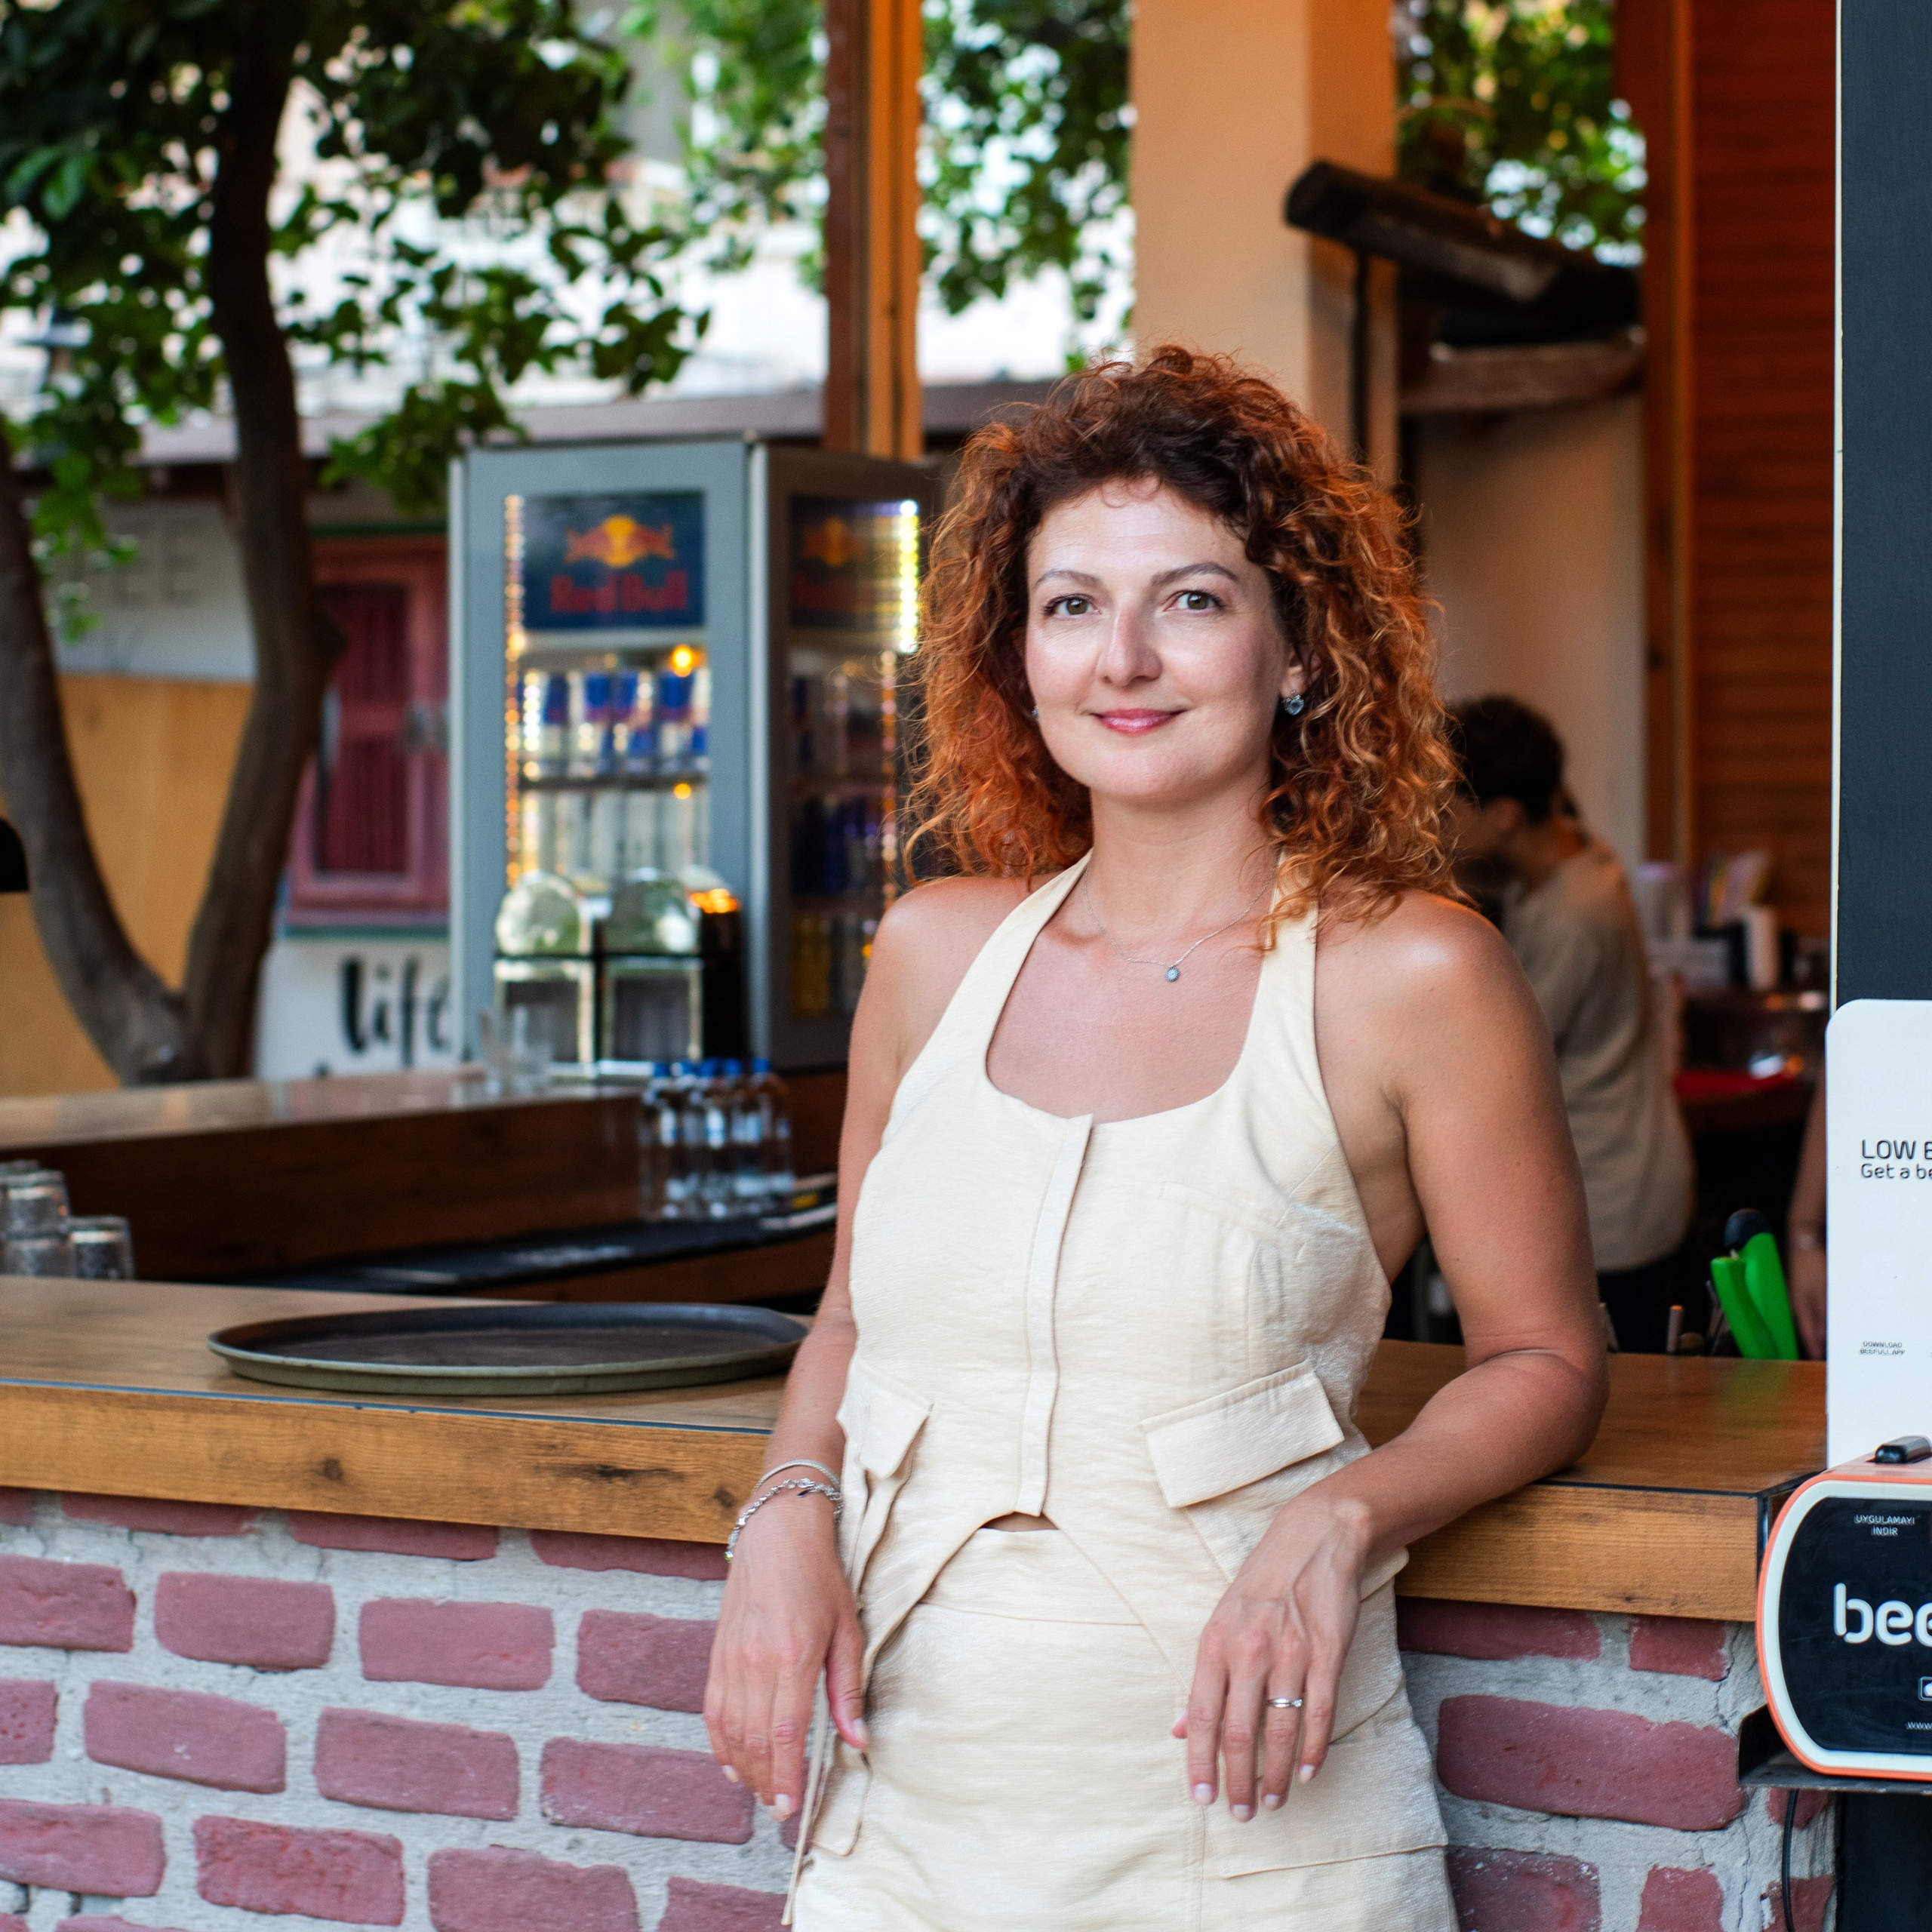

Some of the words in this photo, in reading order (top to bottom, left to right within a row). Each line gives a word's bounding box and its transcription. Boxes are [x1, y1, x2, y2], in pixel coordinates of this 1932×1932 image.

[1862, 1139, 1917, 1160] LOW
[1861, 1163, 1895, 1179] Get
[1900, 1167, 1911, 1179] a
[1863, 1340, 1903, 1349] DOWNLOAD
[1854, 1514, 1915, 1525] UYGULAMAYI
[1871, 1524, 1899, 1536] İNDİR
